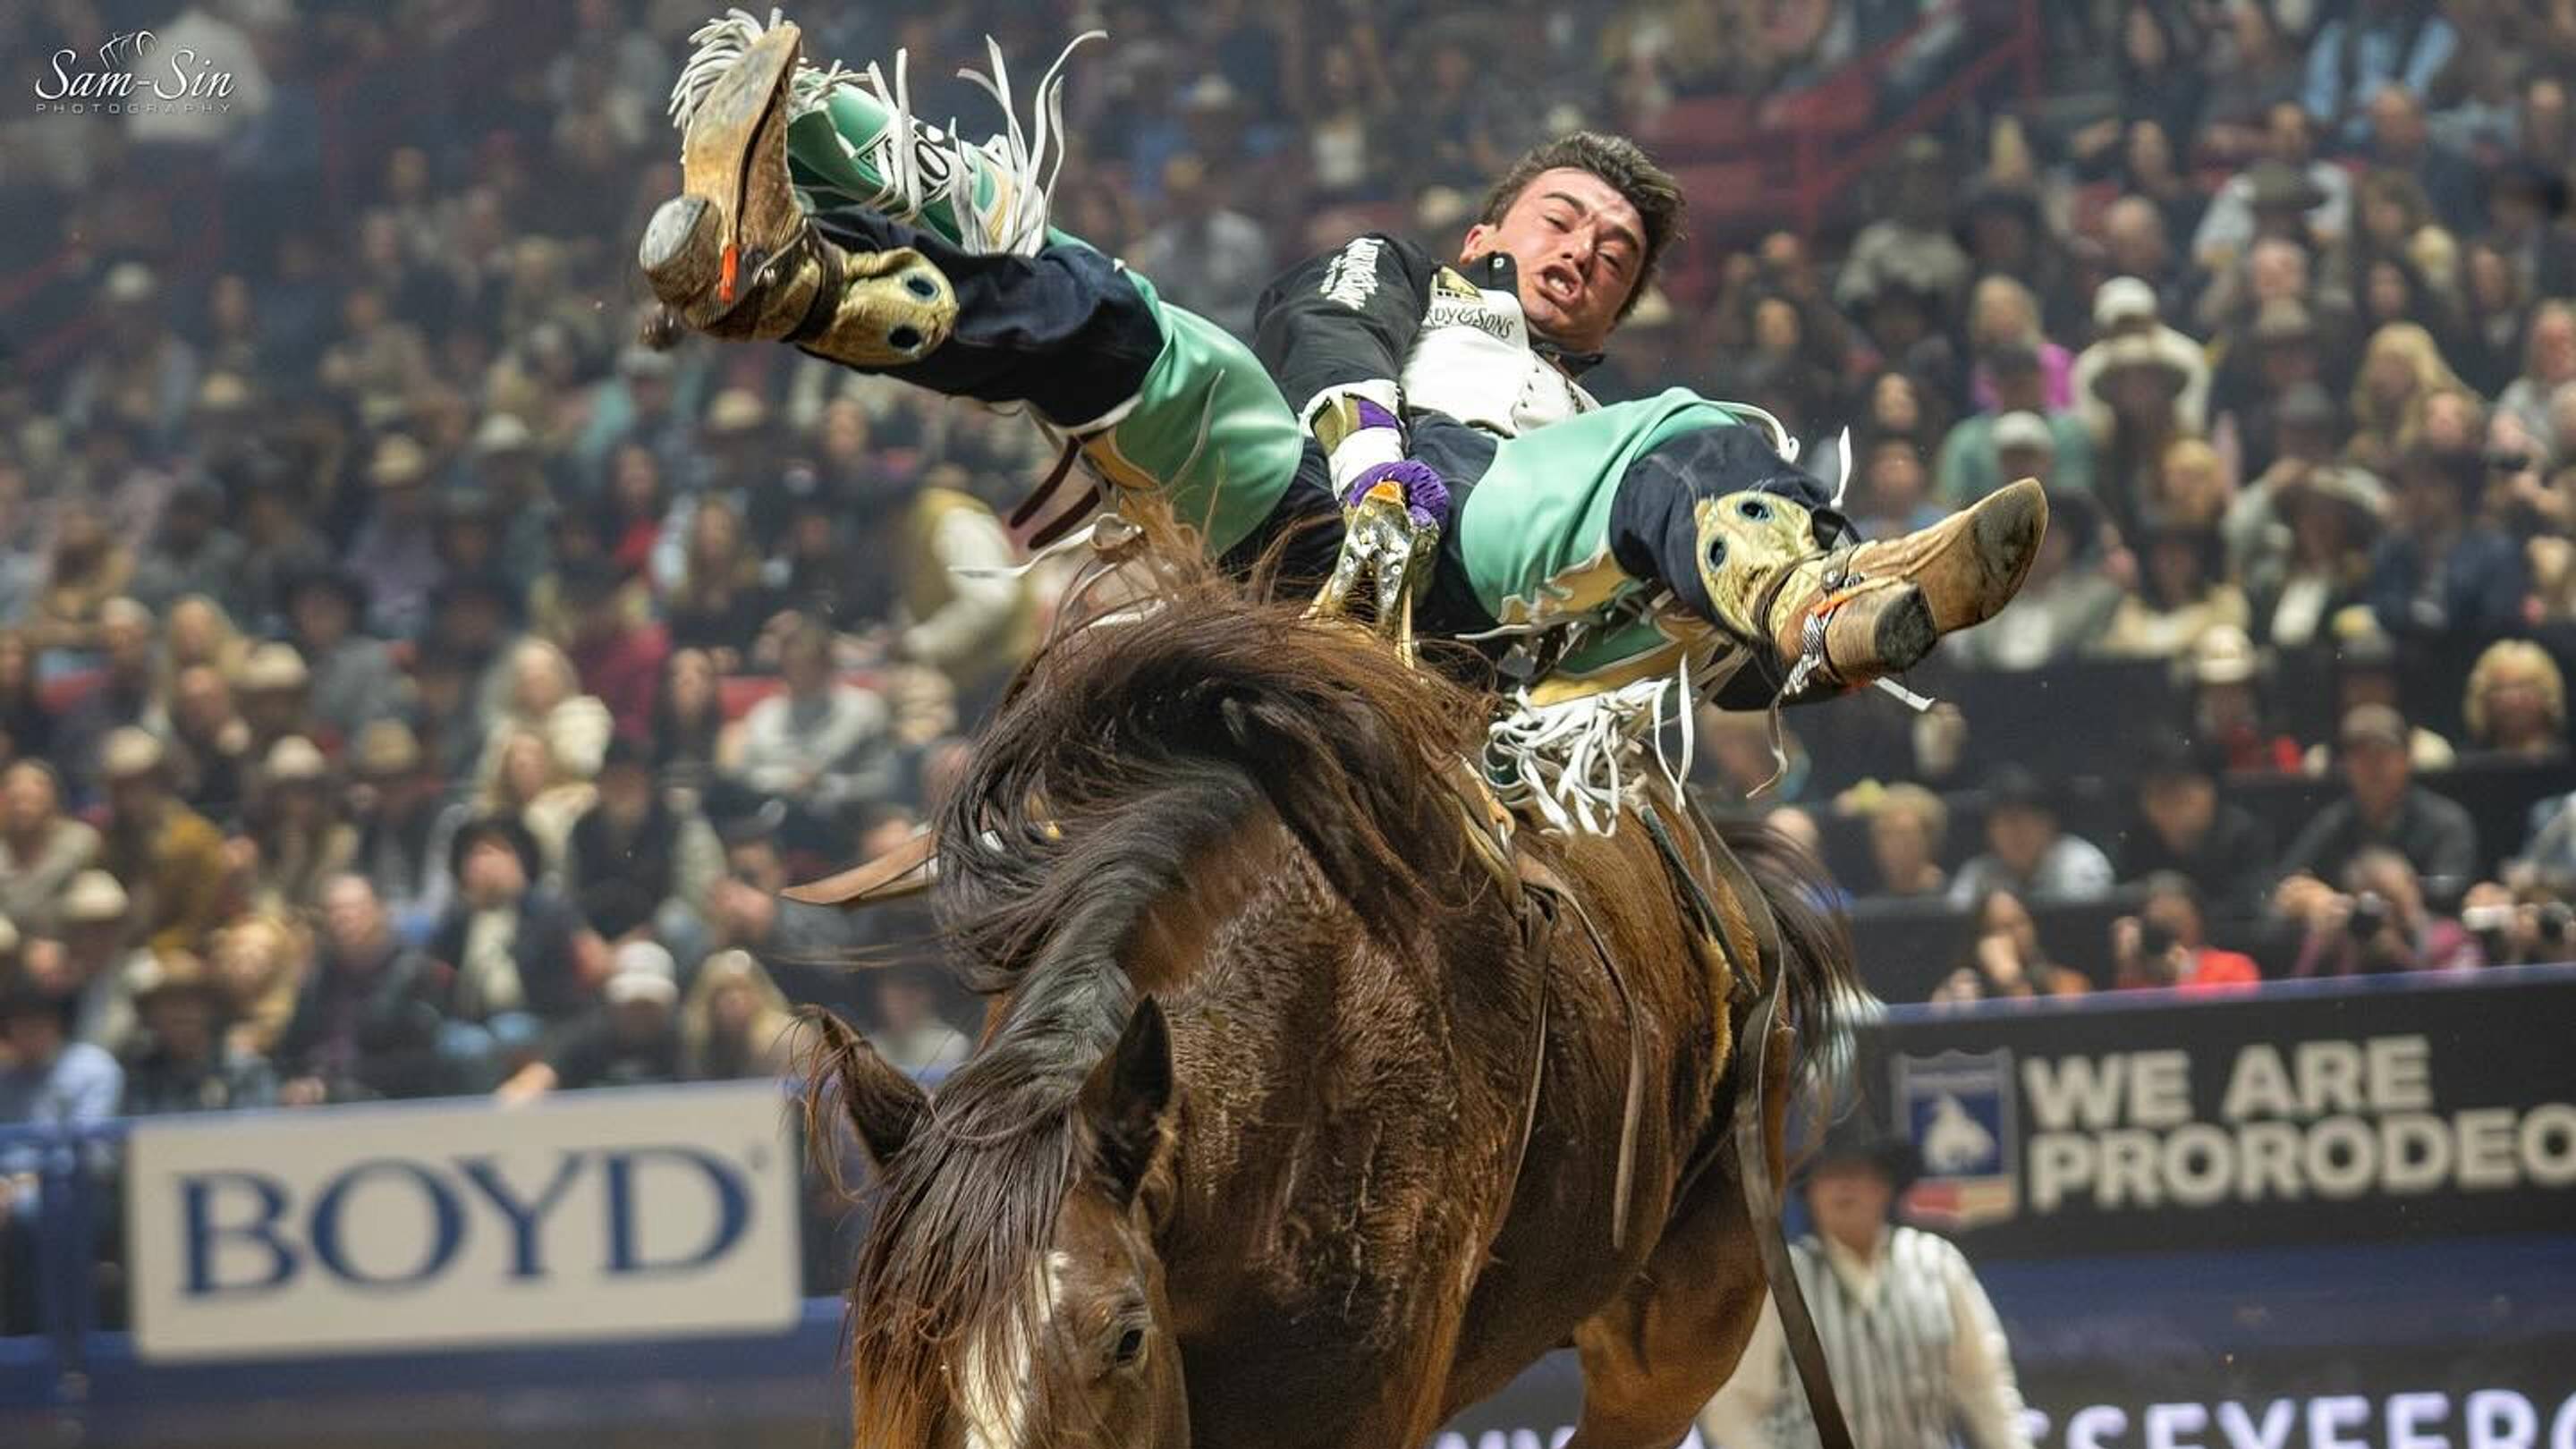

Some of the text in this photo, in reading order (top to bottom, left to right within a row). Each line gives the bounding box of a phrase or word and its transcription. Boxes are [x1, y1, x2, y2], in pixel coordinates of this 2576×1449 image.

[2023, 1034, 2431, 1128] WE ARE
[2028, 1104, 2576, 1211] PRORODEO
[179, 1144, 753, 1298] BOYD
